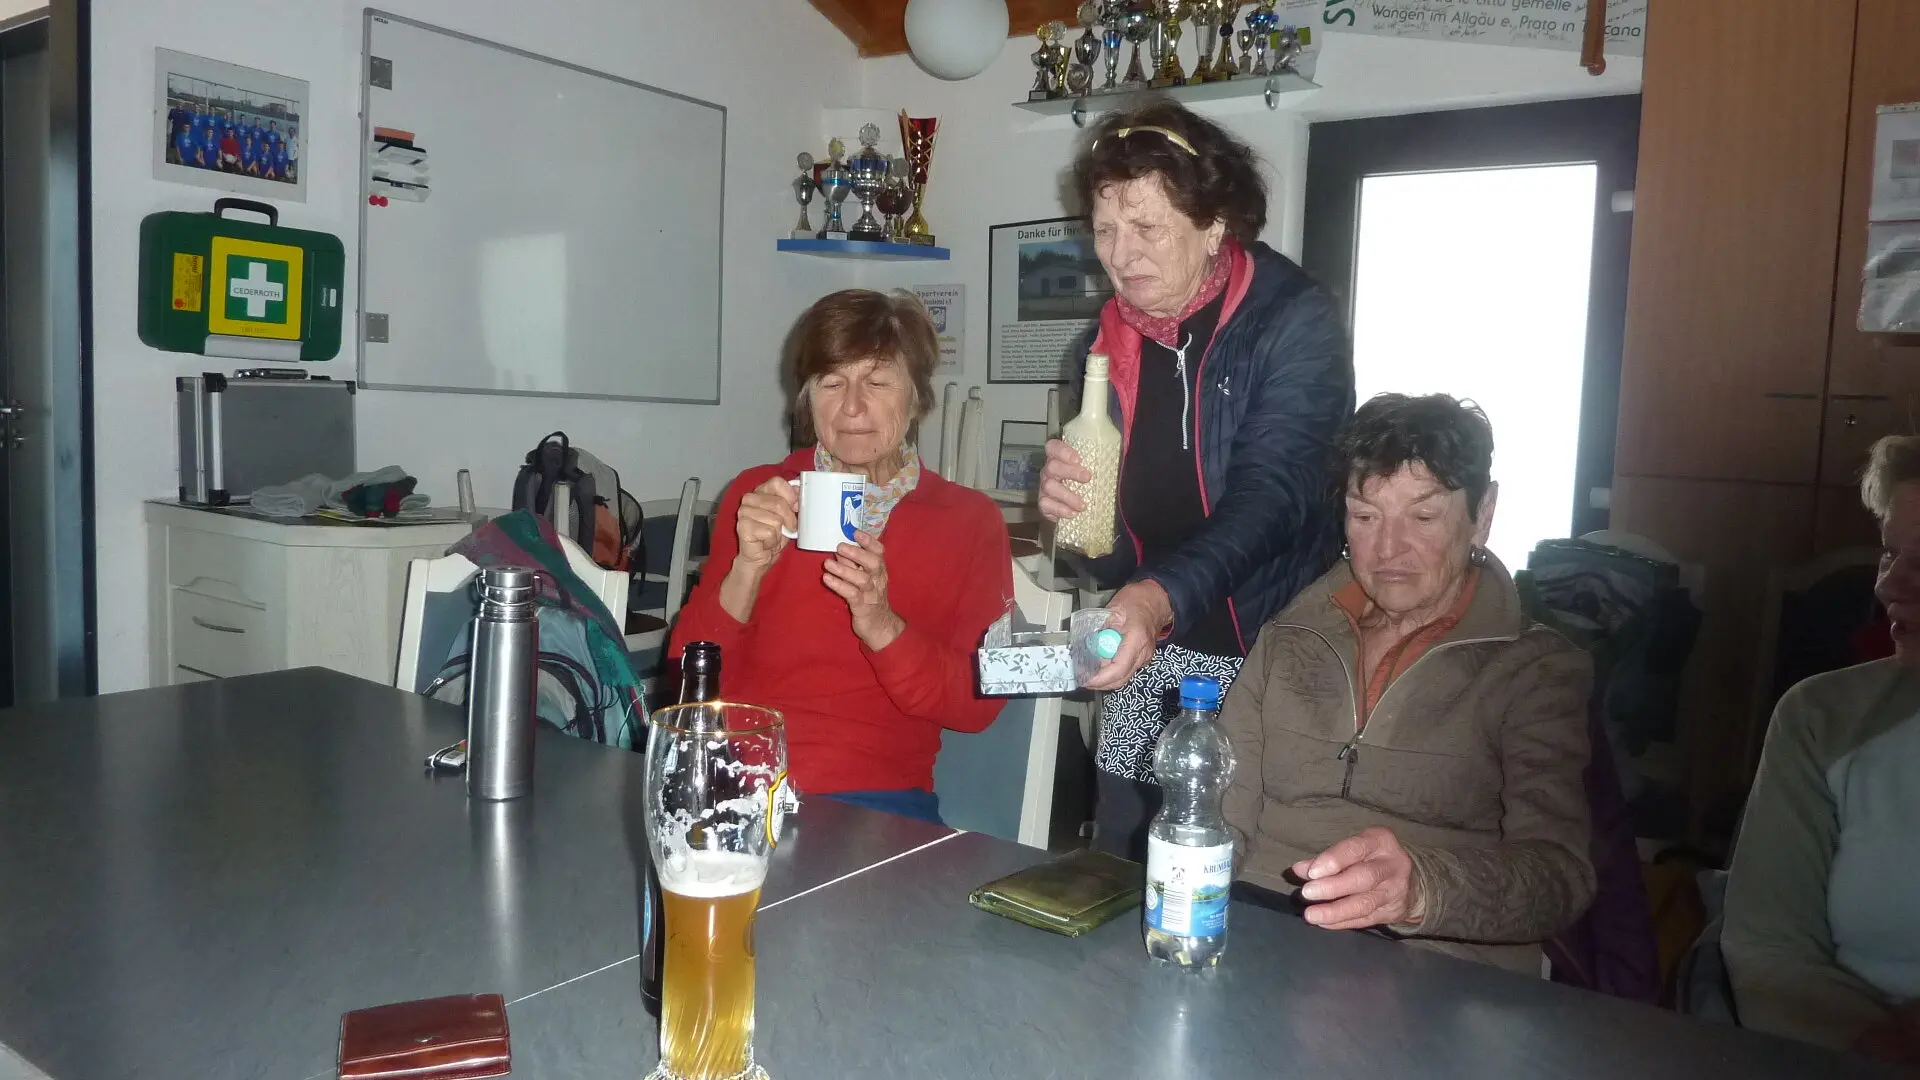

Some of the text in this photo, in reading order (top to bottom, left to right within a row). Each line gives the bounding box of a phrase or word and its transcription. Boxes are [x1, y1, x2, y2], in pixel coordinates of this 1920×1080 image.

[1372, 4, 1425, 23] Wangen
[1430, 11, 1446, 22] im
[1451, 11, 1495, 28] Allgäu
[1519, 15, 1557, 31] Prato
[1562, 21, 1575, 33] in
[1018, 228, 1046, 240] Danke
[1048, 227, 1061, 237] für
[233, 287, 280, 299] CEDERROTH
[917, 289, 959, 298] Sportverein
